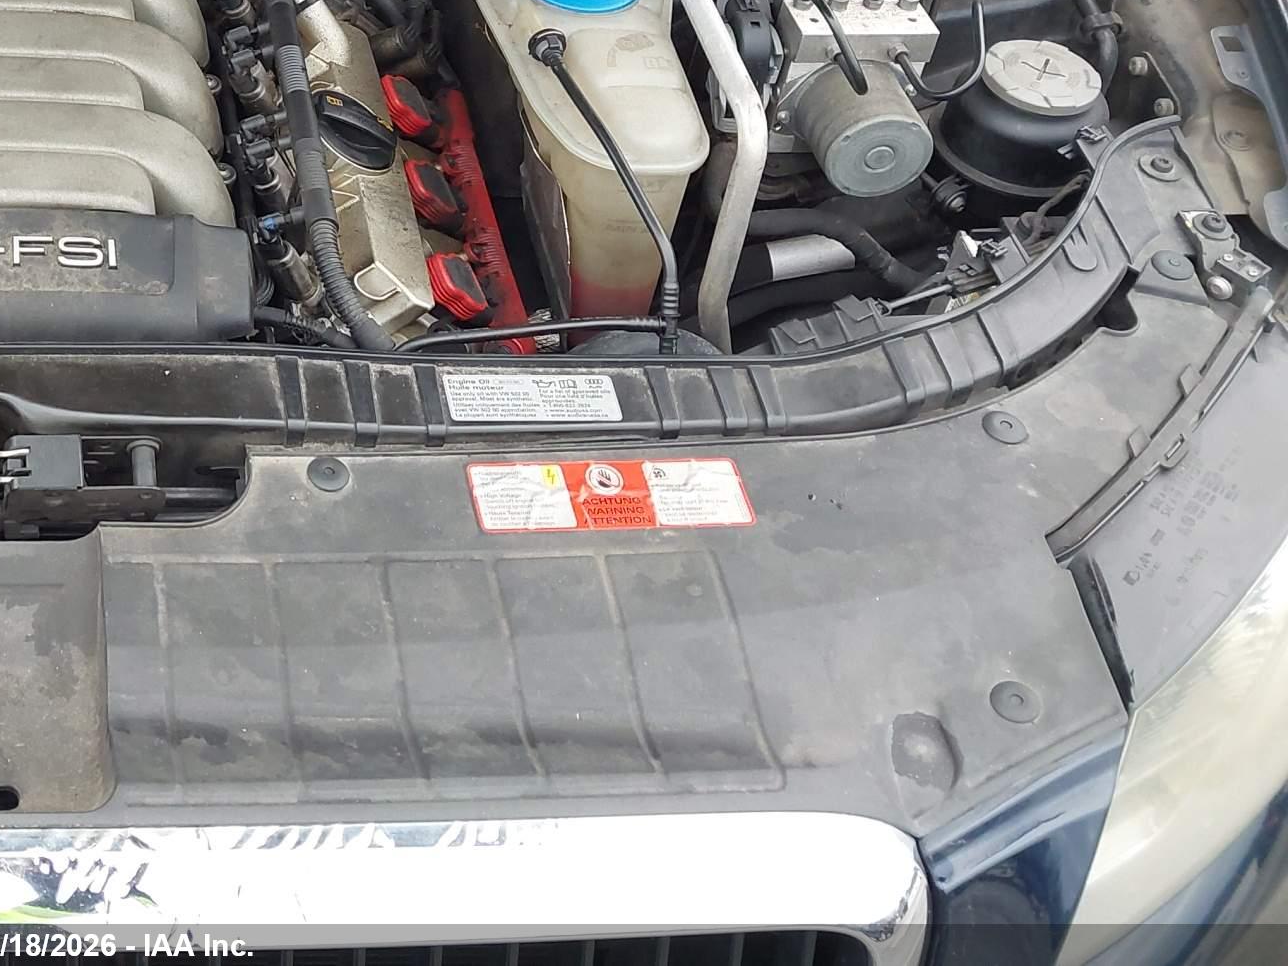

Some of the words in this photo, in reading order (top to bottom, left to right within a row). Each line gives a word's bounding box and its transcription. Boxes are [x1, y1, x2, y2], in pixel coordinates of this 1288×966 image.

[447, 378, 476, 386] Engine
[582, 496, 641, 506] ACHTUNG
[586, 506, 645, 515] WARNING
